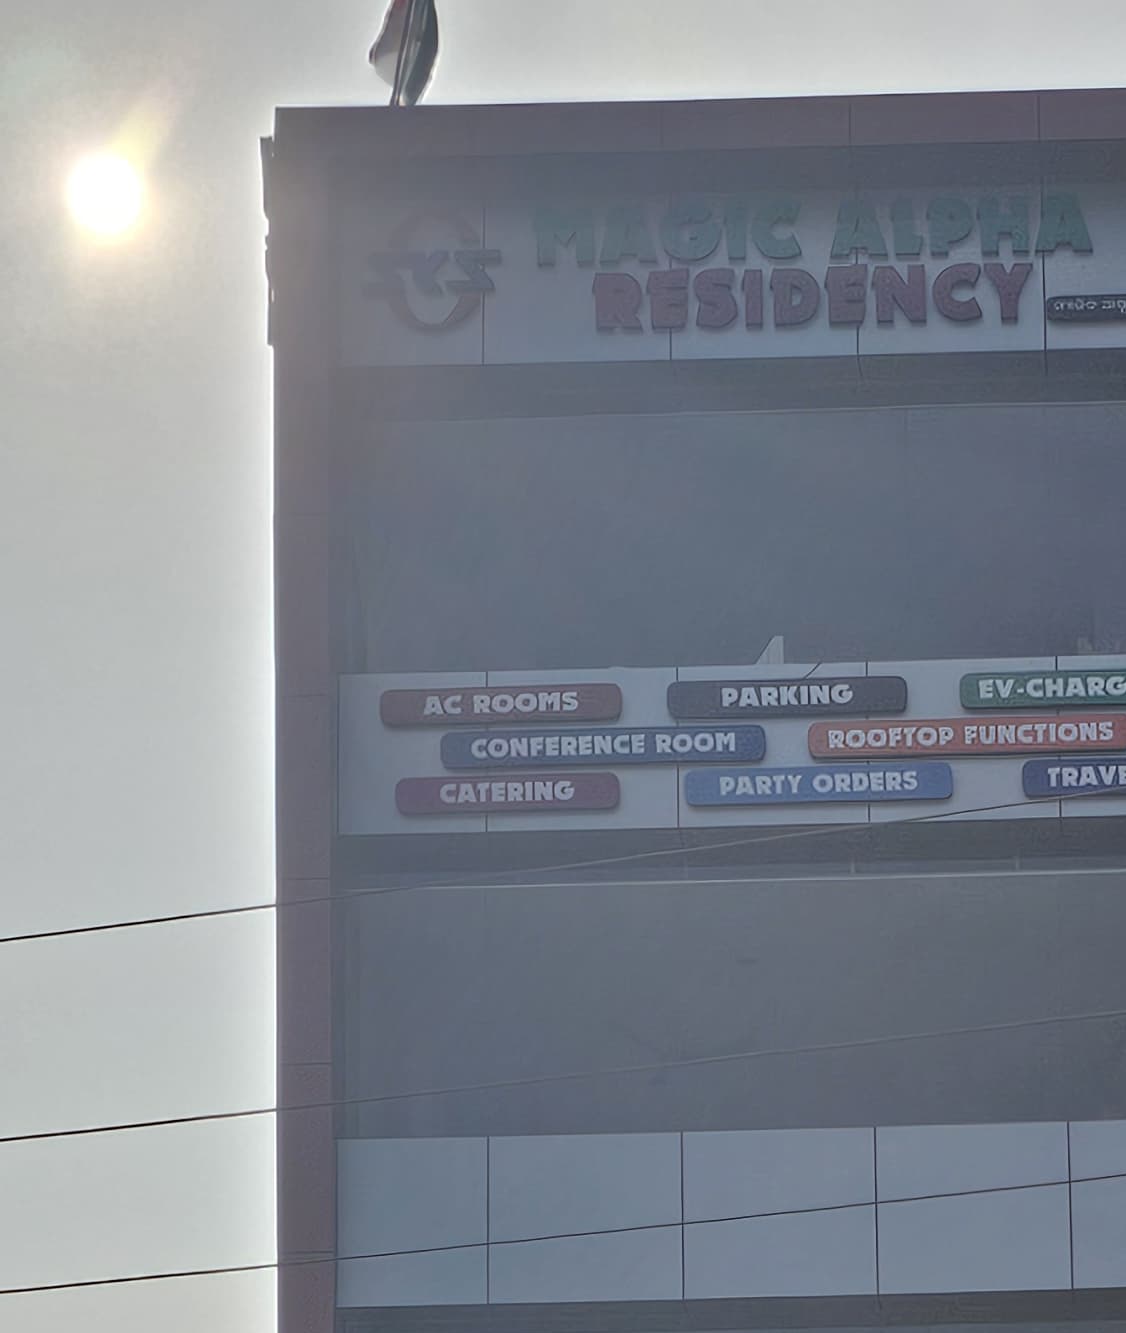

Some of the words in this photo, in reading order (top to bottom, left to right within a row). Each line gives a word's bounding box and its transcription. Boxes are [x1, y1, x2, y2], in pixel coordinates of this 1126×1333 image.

[532, 200, 802, 268] MAGIC
[830, 193, 1094, 262] ALPHA
[592, 262, 1034, 334] RESIDENCY
[424, 695, 462, 717] AC
[474, 691, 579, 715] ROOMS
[721, 683, 854, 707] PARKING
[470, 733, 645, 760] CONFERENCE
[655, 732, 737, 755] ROOM
[828, 726, 955, 749] ROOFTOP
[964, 721, 1113, 745] FUNCTIONS
[439, 780, 575, 805] CATERING
[719, 775, 802, 796] PARTY
[812, 770, 918, 794] ORDERS
